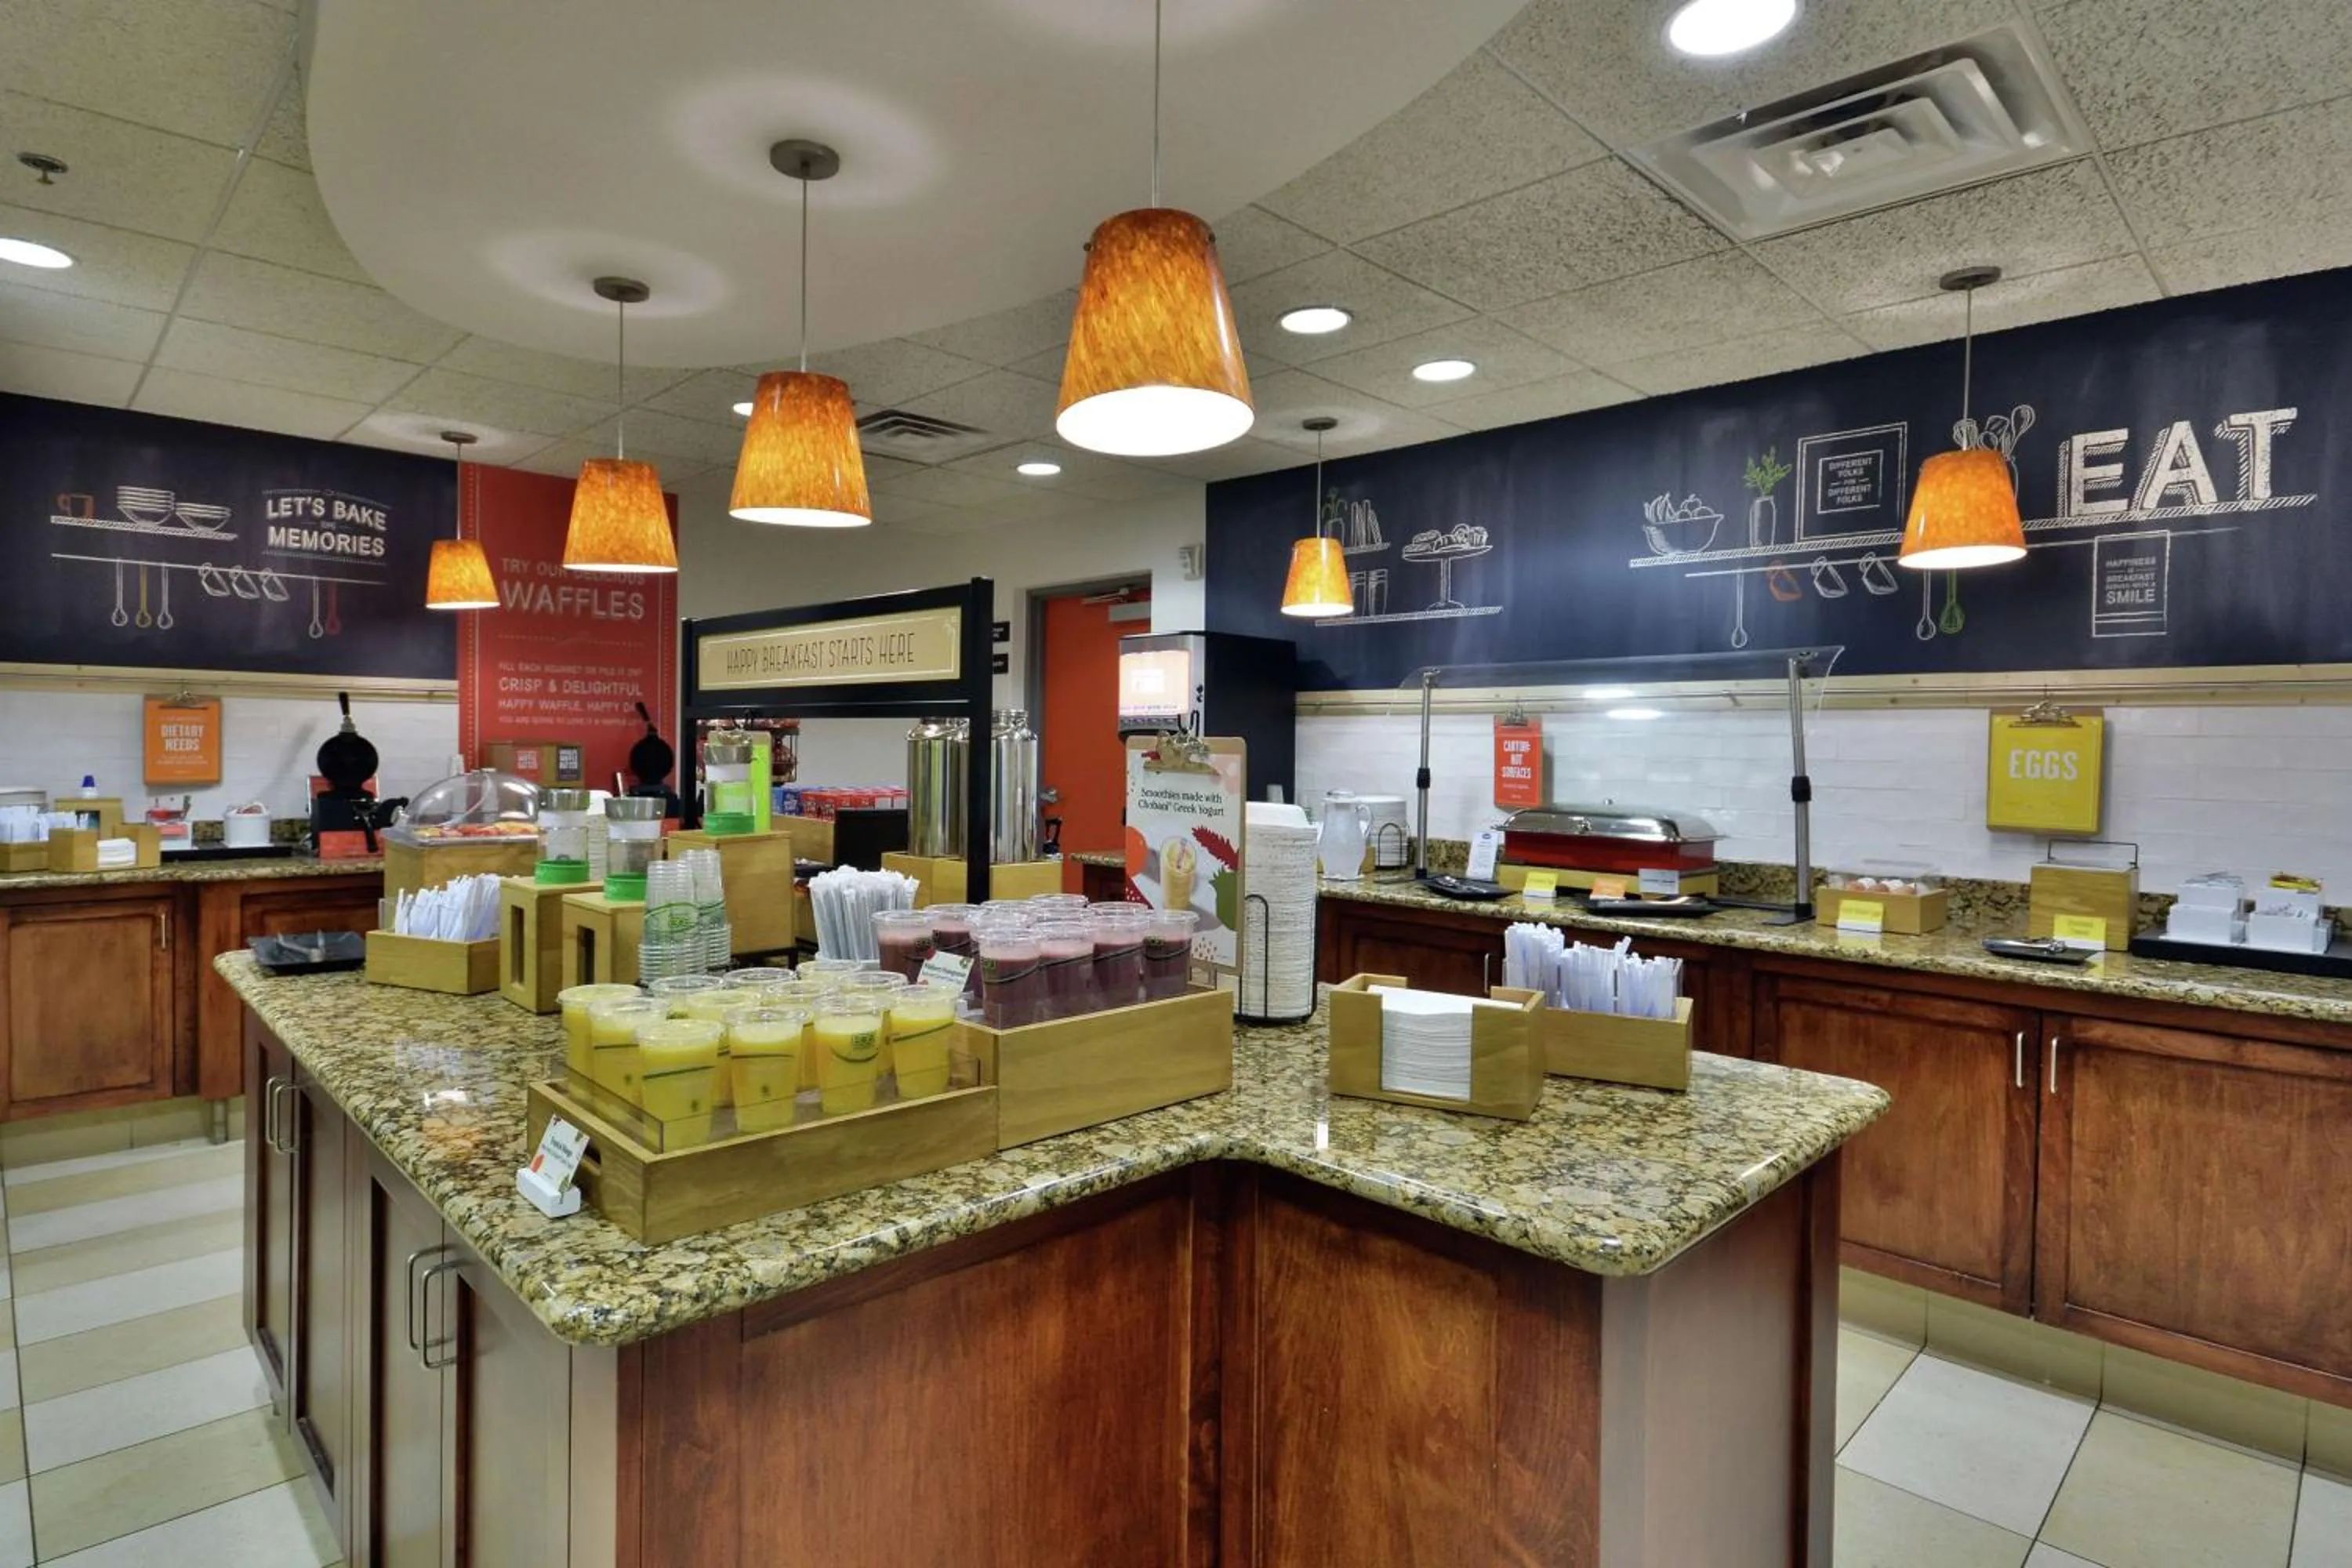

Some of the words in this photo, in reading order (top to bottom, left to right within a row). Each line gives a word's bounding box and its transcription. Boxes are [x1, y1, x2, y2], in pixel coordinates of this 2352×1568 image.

[1828, 457, 1874, 470] DIFFERENT
[2057, 407, 2298, 518] EAT
[1838, 467, 1864, 477] FOLKS
[1828, 484, 1872, 497] DIFFERENT
[1836, 495, 1863, 504] FOLKS
[266, 496, 326, 519] LET'S
[332, 499, 387, 531] BAKE
[267, 526, 386, 557] MEMORIES
[501, 558, 531, 574] TRY
[536, 561, 568, 578] OUR
[500, 580, 646, 620] WAFFLES
[2106, 588, 2156, 604] SMILE
[727, 647, 758, 674] HAPPY
[762, 640, 825, 673] BREAKFAST
[829, 636, 874, 667] STARTS
[879, 633, 916, 664] HERE
[499, 677, 543, 691] CRISP
[548, 679, 557, 693] &
[563, 680, 643, 696] DELIGHTFUL
[499, 699, 534, 710] HAPPY
[587, 702, 620, 713] HAPPY
[623, 703, 637, 713] DA
[161, 724, 205, 738] DIETARY
[1510, 753, 1524, 765] HOT
[2009, 749, 2080, 781] EGGS
[1141, 787, 1180, 800] Smoothies
[1181, 791, 1203, 802] made
[1204, 792, 1223, 804] with
[1174, 802, 1197, 814] Greek
[1199, 804, 1225, 817] Yogurt
